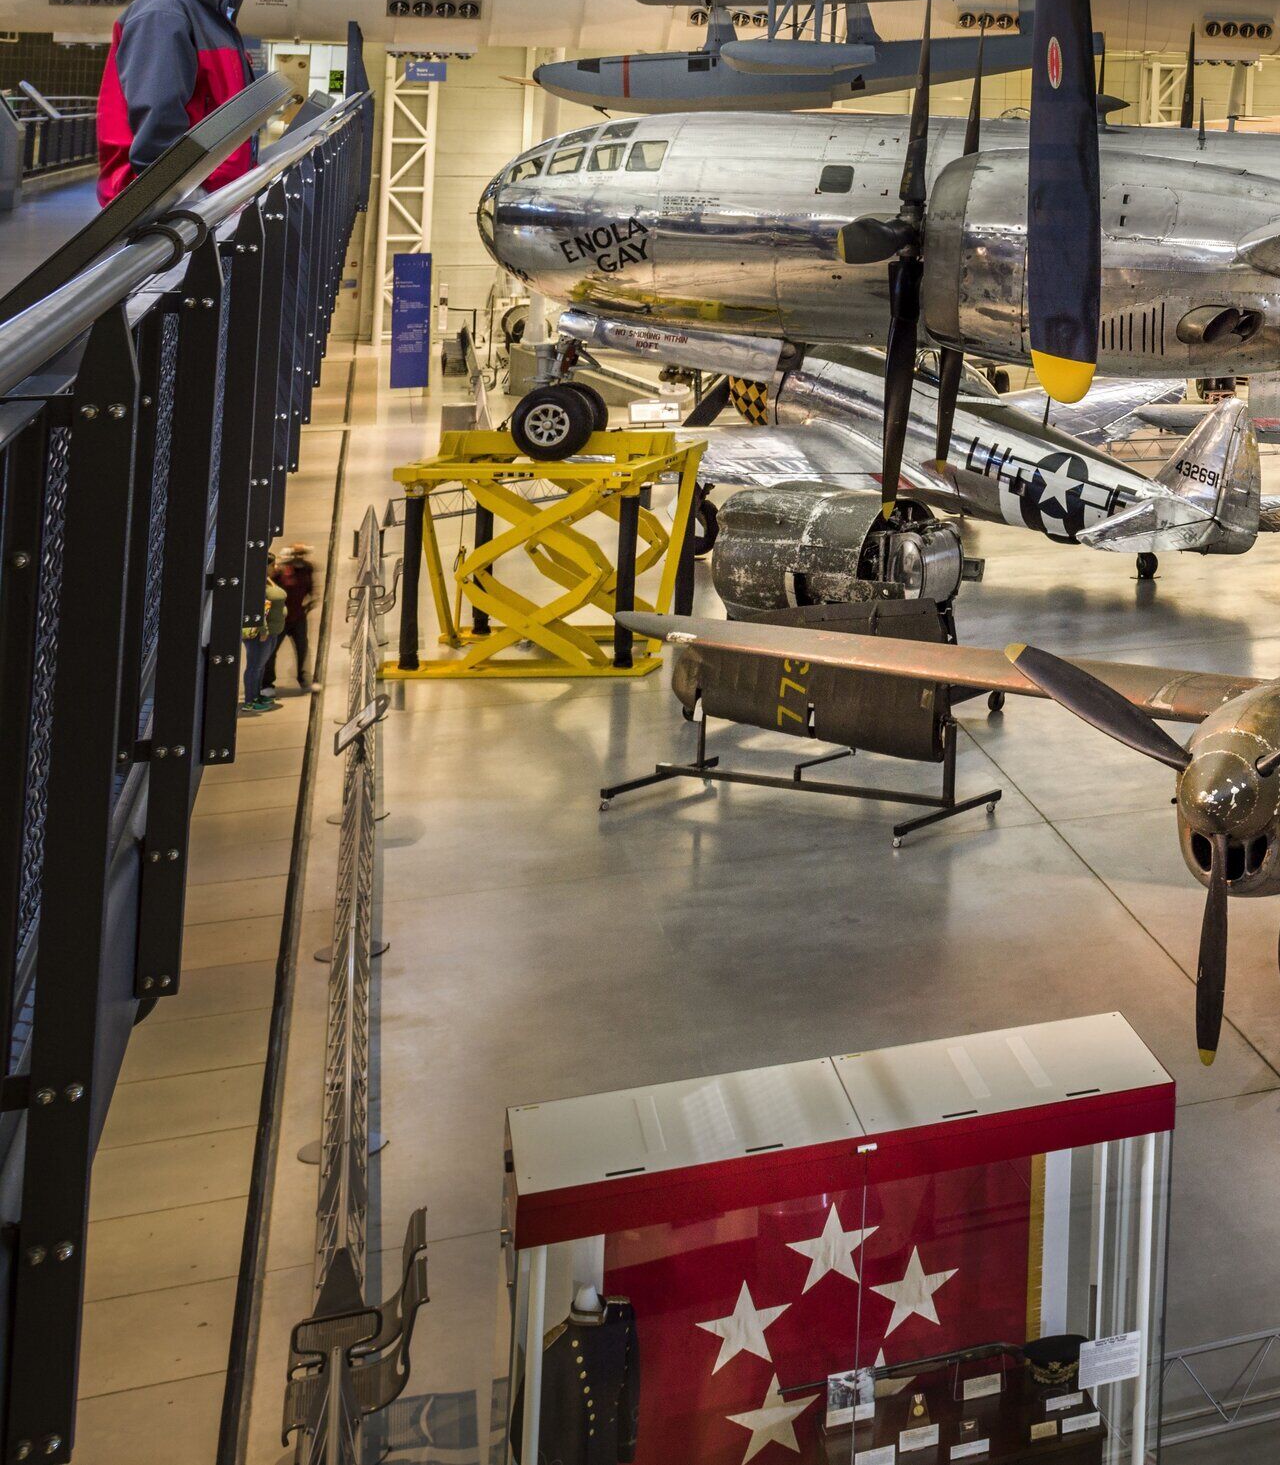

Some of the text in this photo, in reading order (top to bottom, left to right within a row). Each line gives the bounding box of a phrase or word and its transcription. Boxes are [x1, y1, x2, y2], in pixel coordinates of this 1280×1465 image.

[559, 216, 649, 264] ENOLA
[596, 238, 649, 273] GAY
[615, 328, 688, 344] NO SMOKING WITHIN
[1174, 458, 1221, 489] 432691
